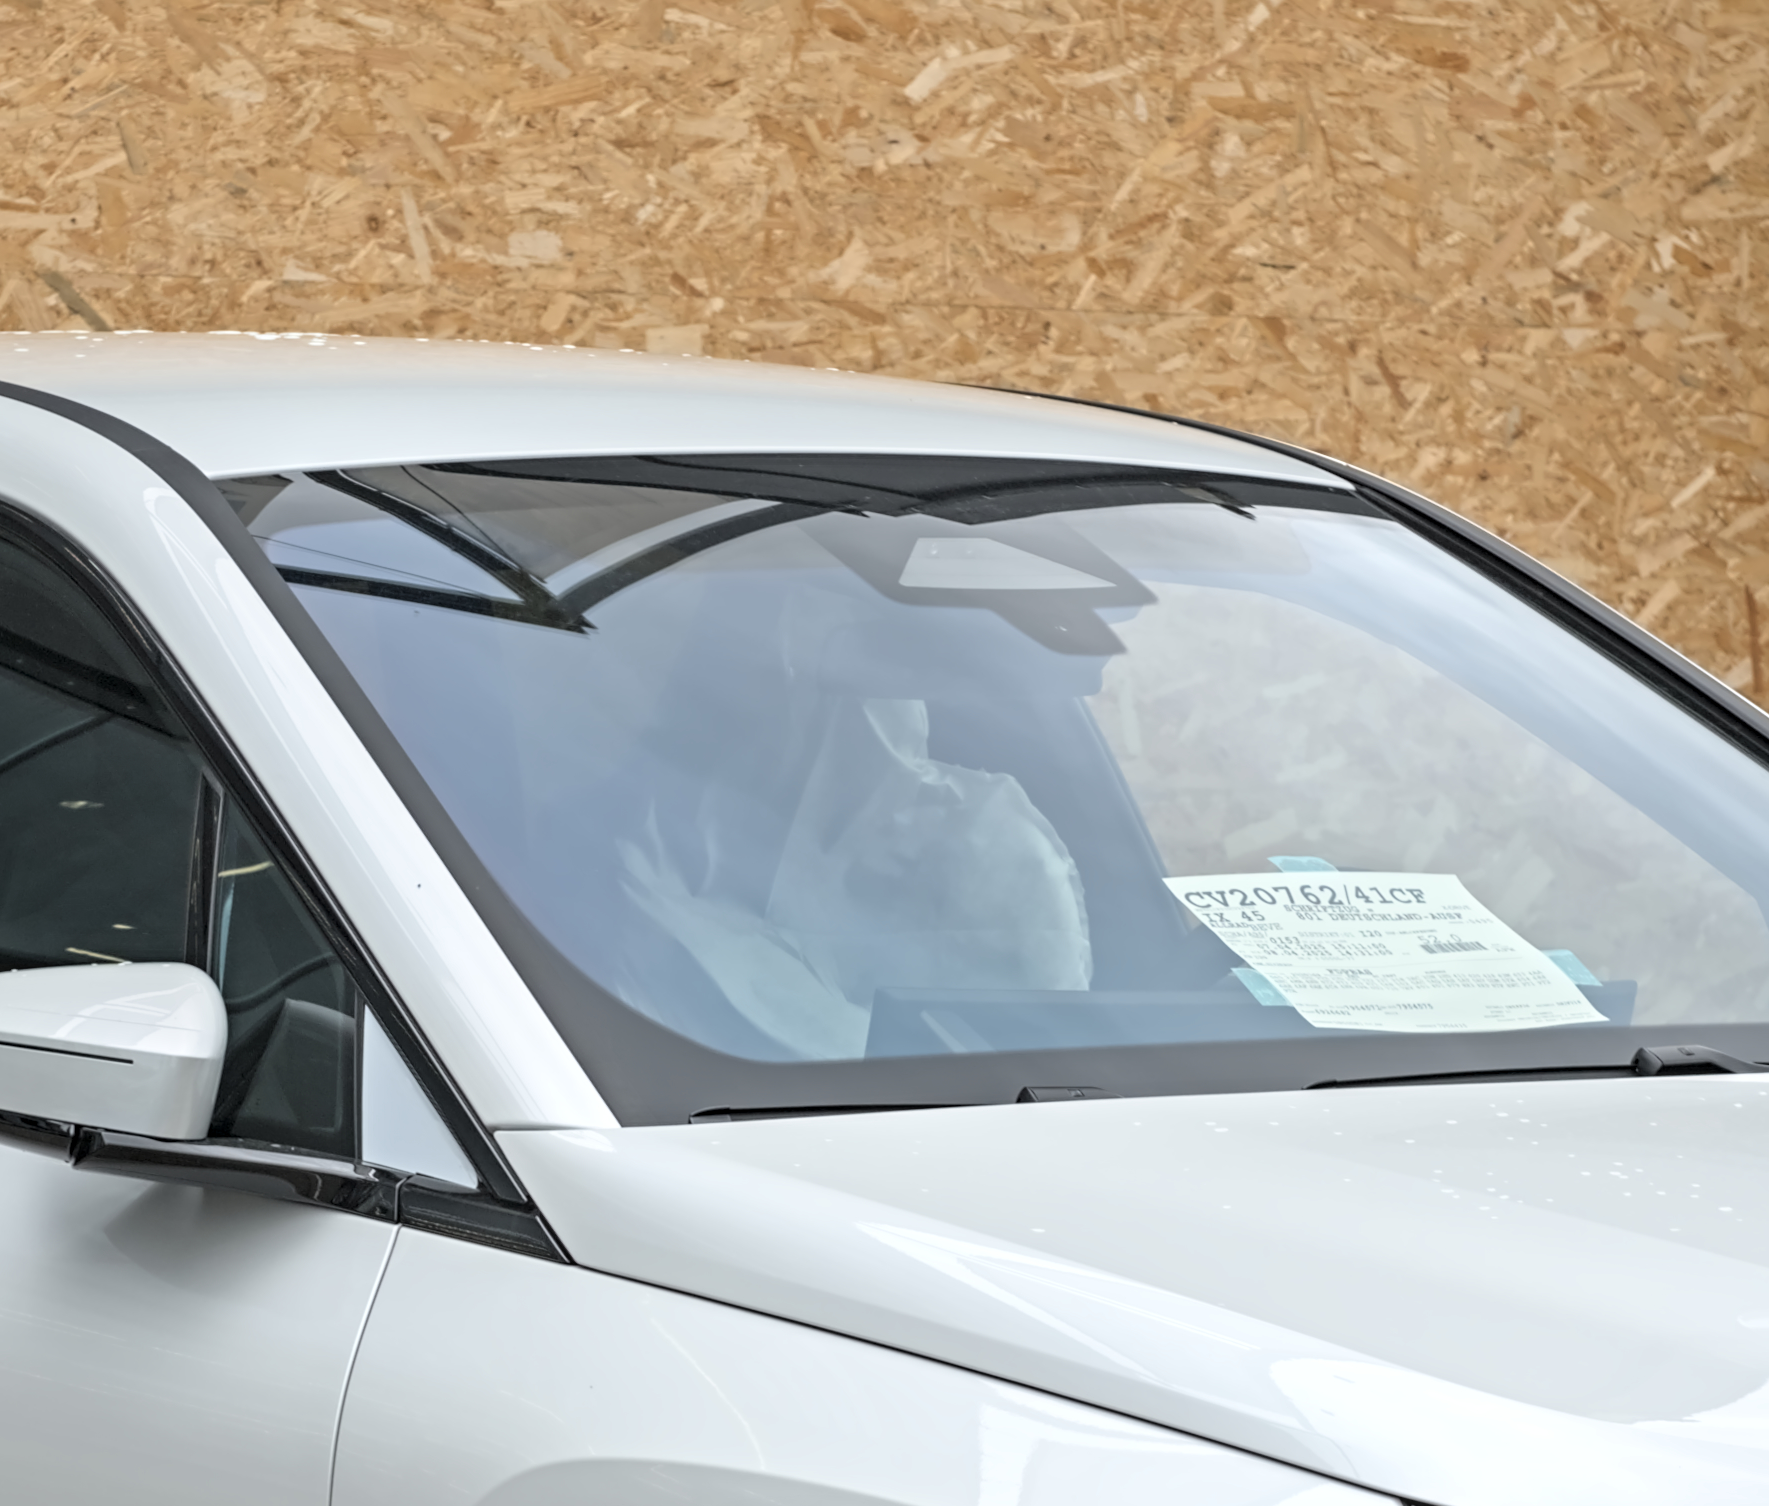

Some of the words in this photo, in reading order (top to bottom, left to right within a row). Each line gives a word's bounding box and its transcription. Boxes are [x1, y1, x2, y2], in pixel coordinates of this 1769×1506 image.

[1184, 885, 1426, 907] CV20762/41CF
[1202, 912, 1230, 922] IX
[1241, 910, 1265, 921] 45
